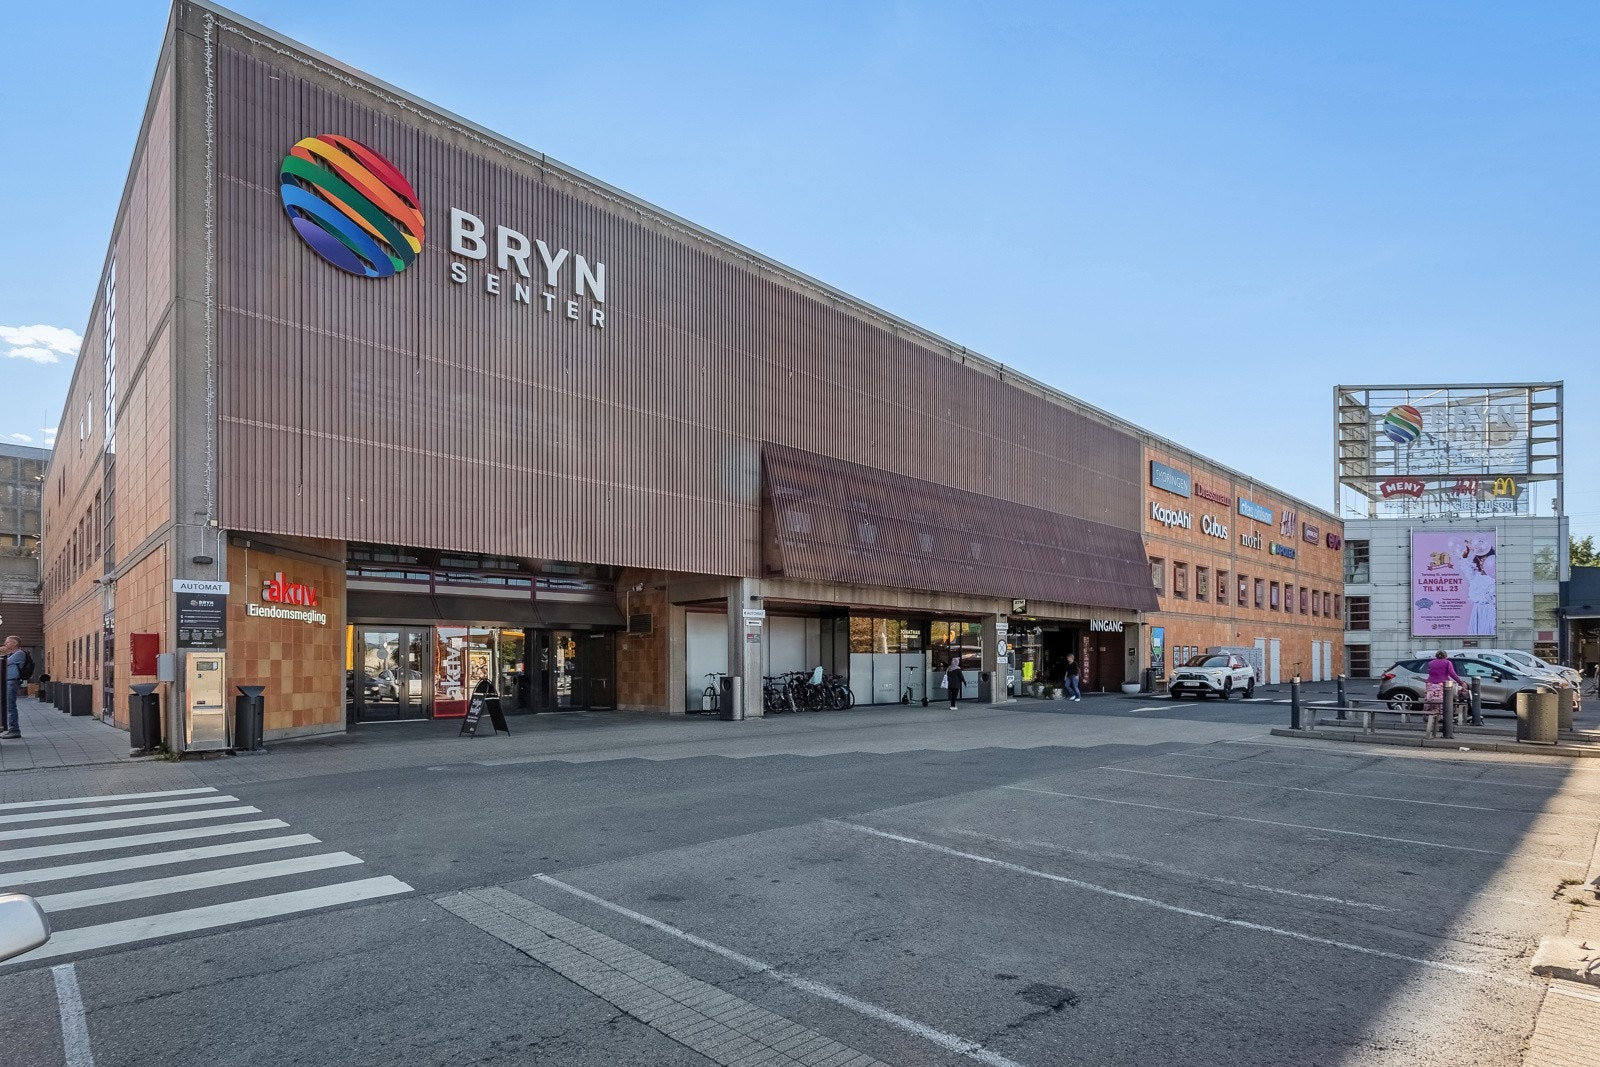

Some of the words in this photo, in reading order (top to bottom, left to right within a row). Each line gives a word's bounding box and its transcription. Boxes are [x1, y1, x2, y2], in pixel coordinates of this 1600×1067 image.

[451, 206, 605, 303] BRYN
[451, 262, 605, 328] SENTER
[1430, 406, 1515, 428] BRYN
[1156, 469, 1188, 490] SKORINGEN
[1386, 482, 1420, 493] MENY
[1152, 501, 1191, 529] KappAhl
[1202, 514, 1228, 540] Cubus
[1241, 530, 1263, 550] norli
[180, 583, 222, 591] AUTOMAT
[1418, 577, 1463, 585] LANGÅPENT
[248, 604, 326, 625] Eiendomsmegling
[1090, 619, 1123, 632] INNGANG
